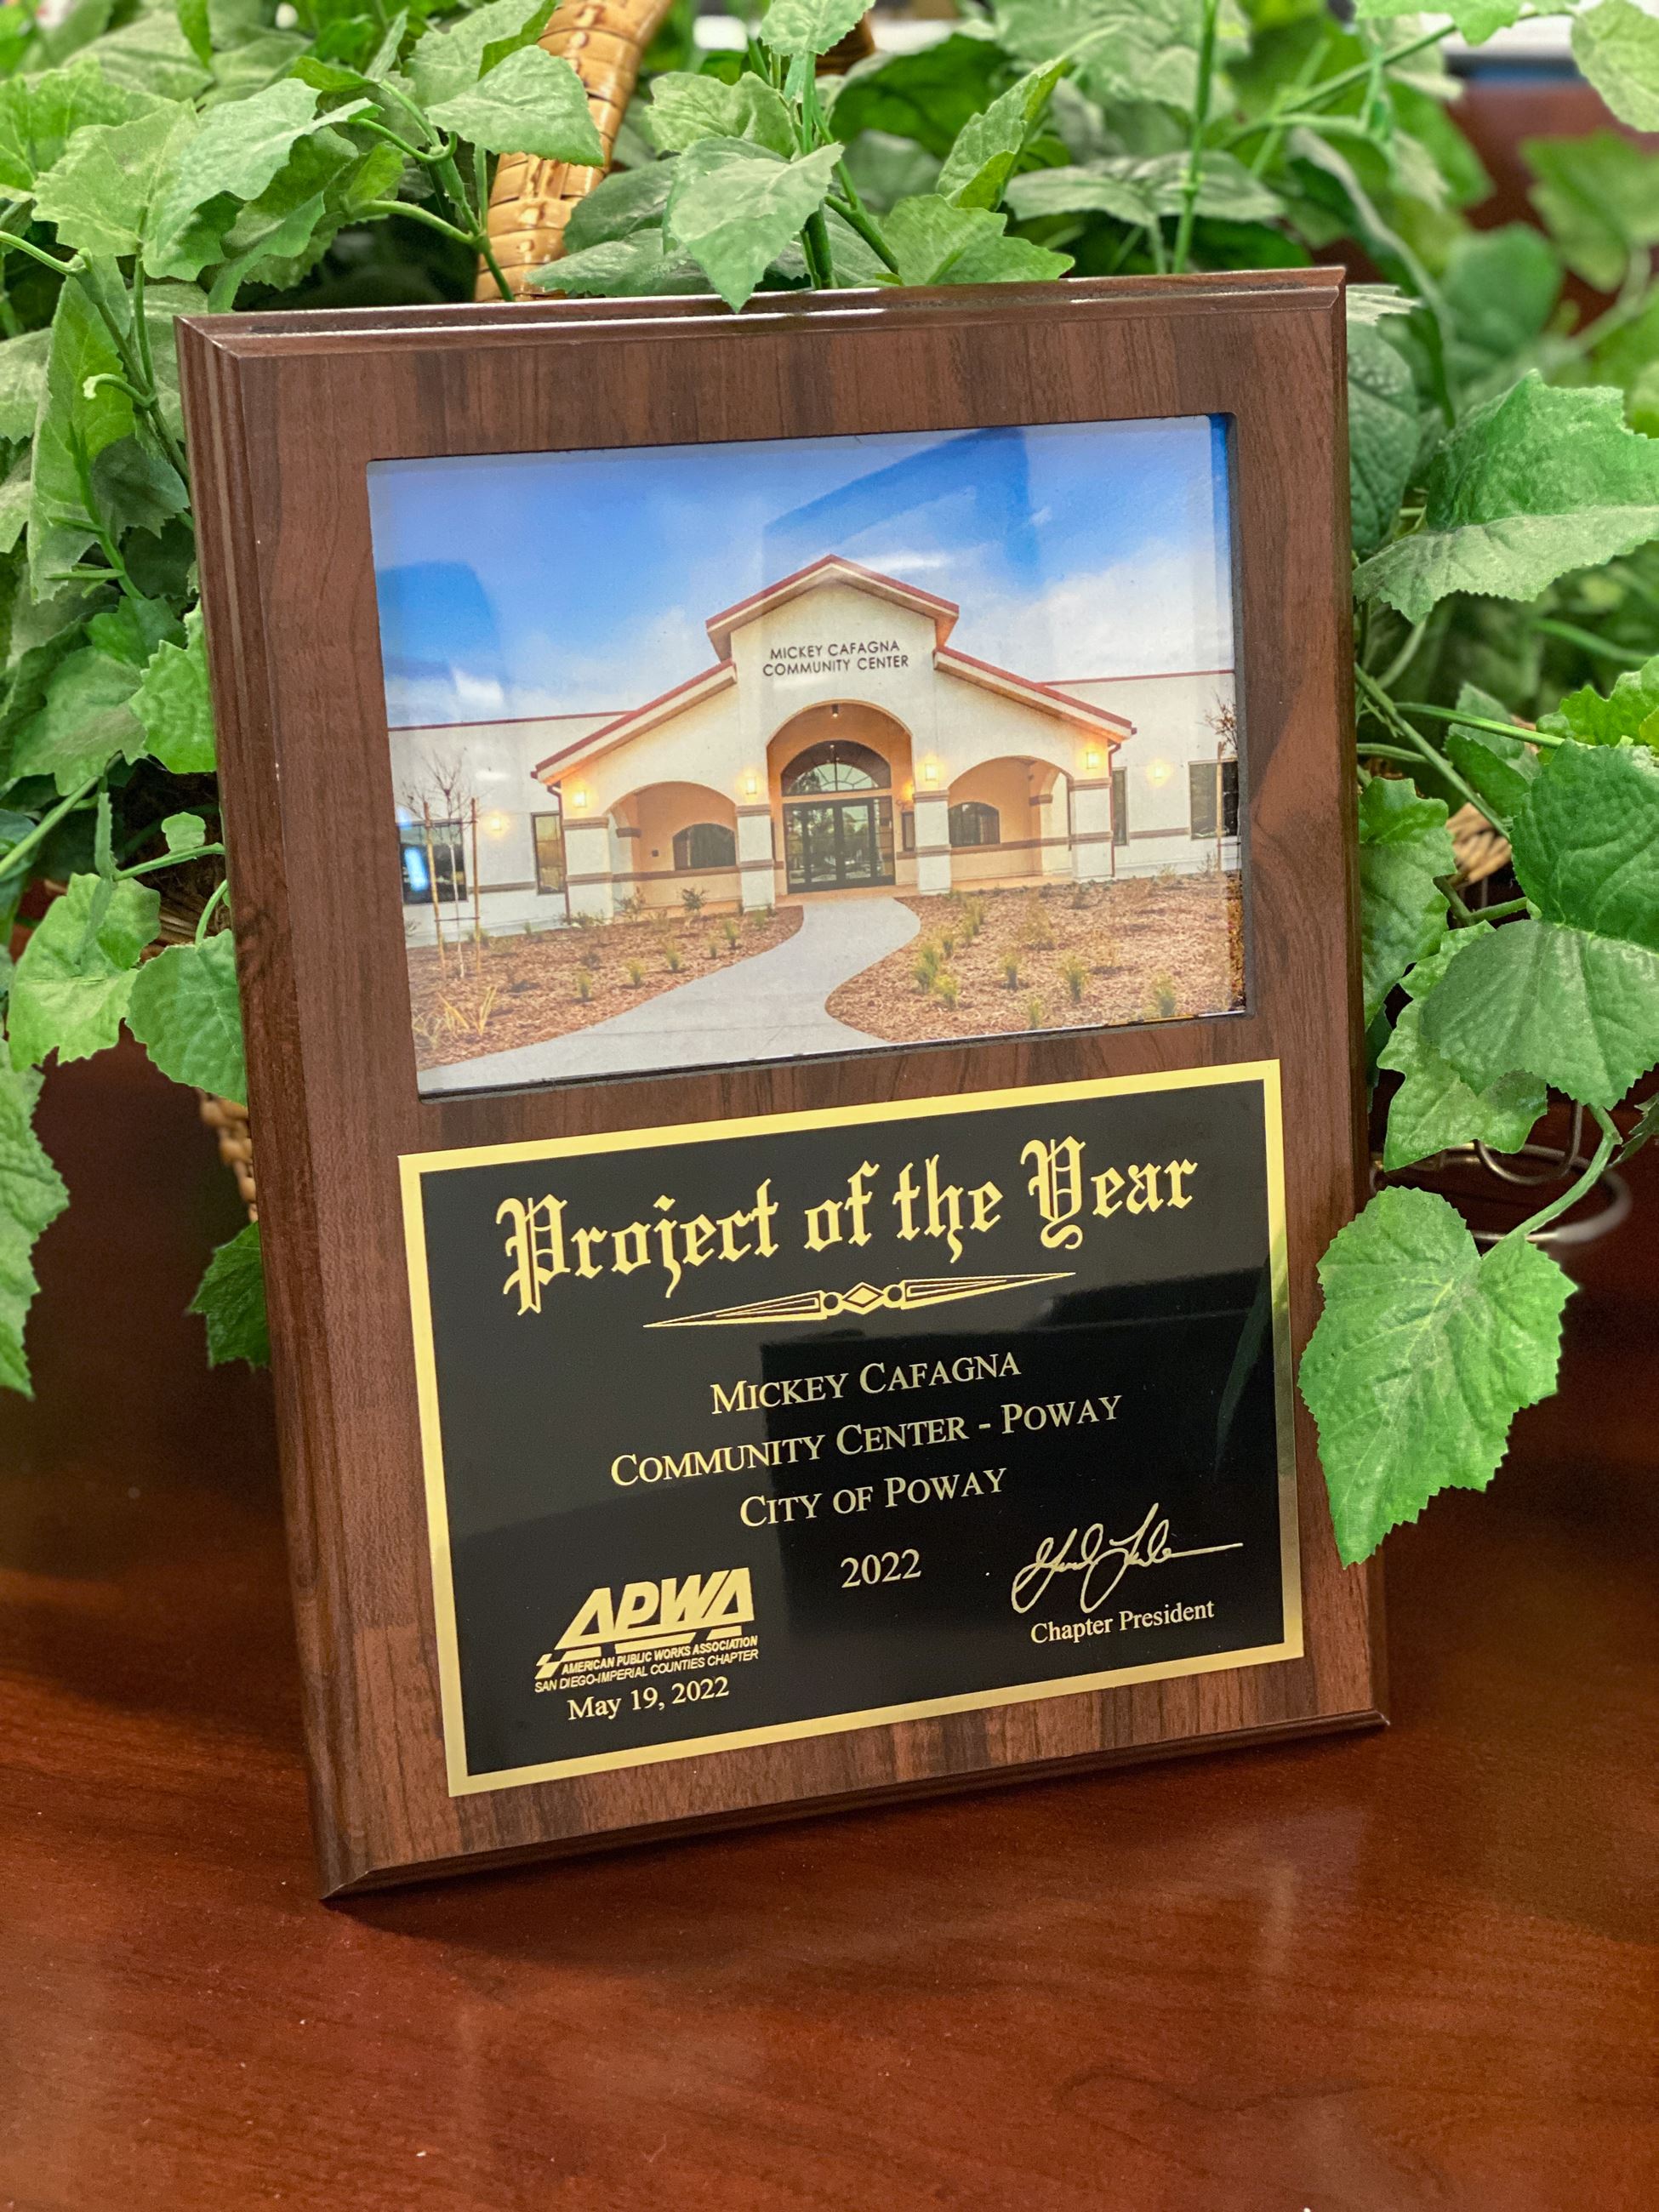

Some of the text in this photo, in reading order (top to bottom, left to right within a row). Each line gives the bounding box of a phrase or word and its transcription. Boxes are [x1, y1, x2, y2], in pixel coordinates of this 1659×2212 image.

[762, 654, 909, 676] COMMUNITY CENTER
[770, 640, 900, 660] MICKEY CAFAGNA
[495, 1135, 1200, 1317] Project of the Year
[710, 1351, 1022, 1415] MICKEY CAFAGNA
[610, 1434, 826, 1487] COMMUNITY
[836, 1416, 969, 1456] CENTER
[1001, 1395, 1123, 1435] POWAY
[739, 1468, 1008, 1529] CITY OF POWAY
[840, 1548, 922, 1589] 2022
[554, 1567, 755, 1650] APWA
[1030, 1600, 1215, 1644] Chapter President
[534, 1649, 759, 1693] SAN DIEGO-IMPERIAL COUNTIES CHAPTER
[562, 1634, 759, 1676] AMERICAN PUBLIC WORKS ASSOCIATION
[567, 1676, 730, 1720] May 19, 2022
